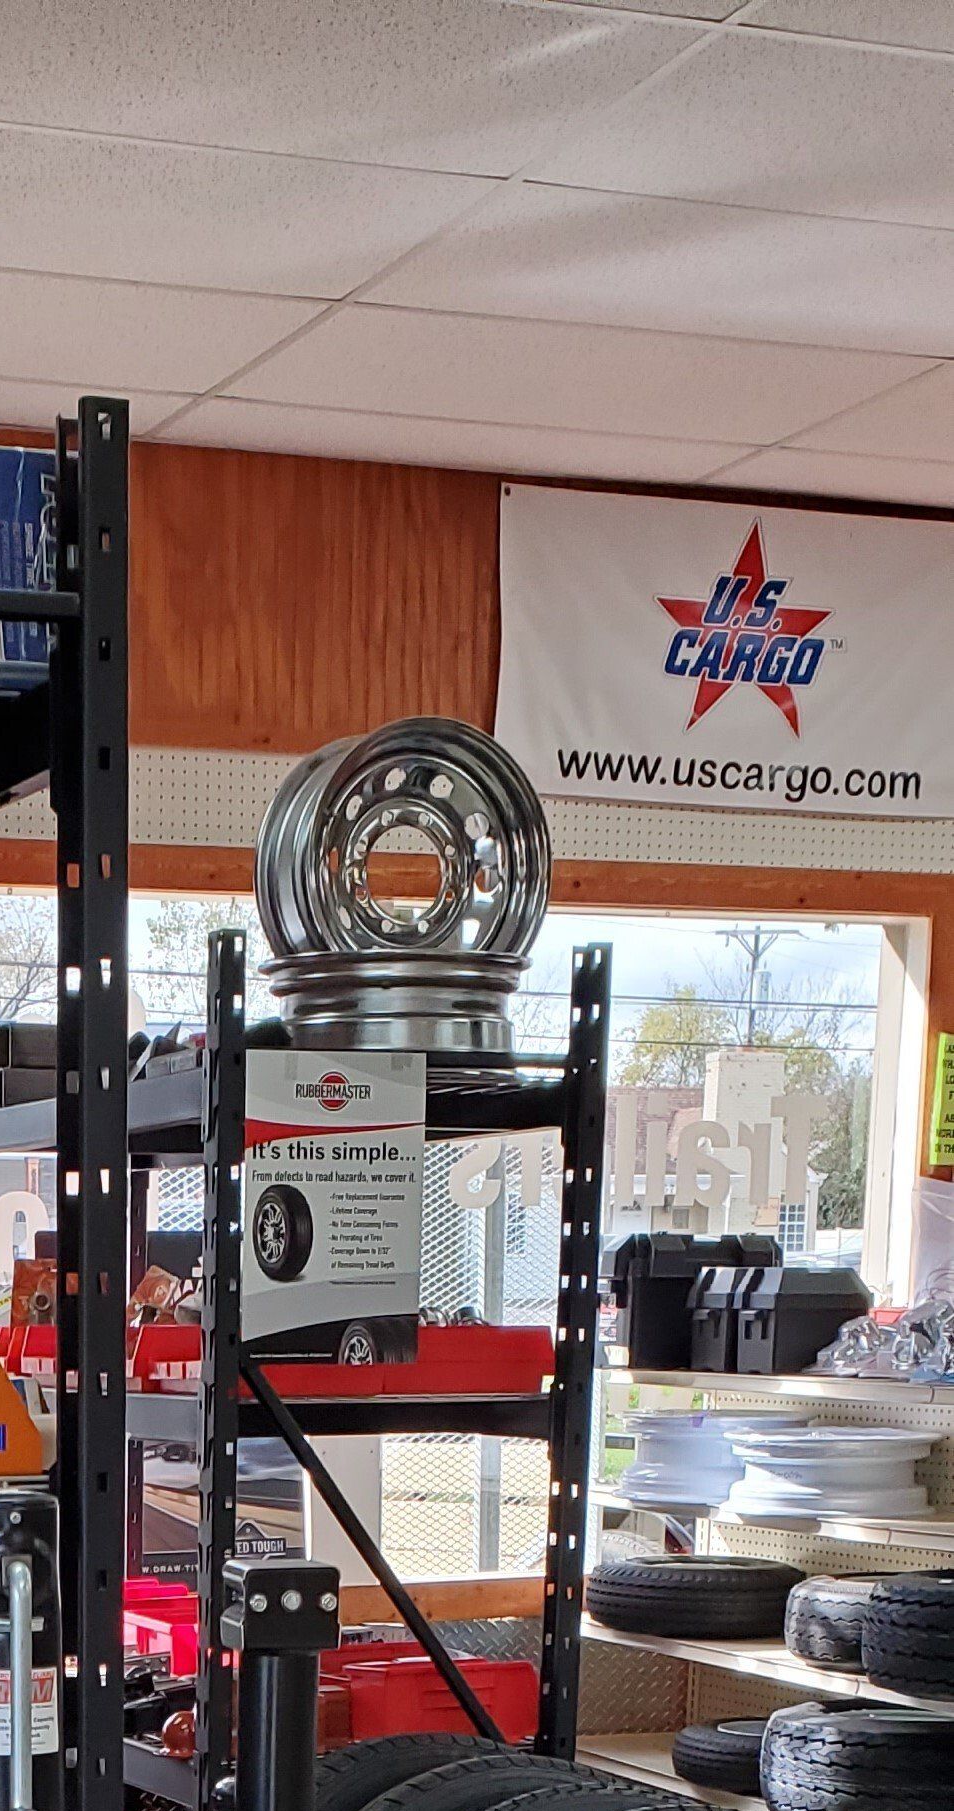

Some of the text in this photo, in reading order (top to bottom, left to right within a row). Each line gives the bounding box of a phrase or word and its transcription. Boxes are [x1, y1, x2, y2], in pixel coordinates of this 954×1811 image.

[703, 576, 789, 631] U.S.
[664, 630, 824, 685] CARGO
[557, 750, 922, 802] www.uscargo.com
[295, 1082, 371, 1099] RUBBERMASTER
[253, 1141, 416, 1165] It's this simple...
[252, 1170, 272, 1181] From
[275, 1170, 303, 1182] defects
[306, 1171, 313, 1181] to
[316, 1171, 333, 1182] road
[335, 1171, 368, 1183] hazards,
[371, 1174, 382, 1182] we
[385, 1174, 406, 1182] cover
[251, 1540, 284, 1553] TOUGH
